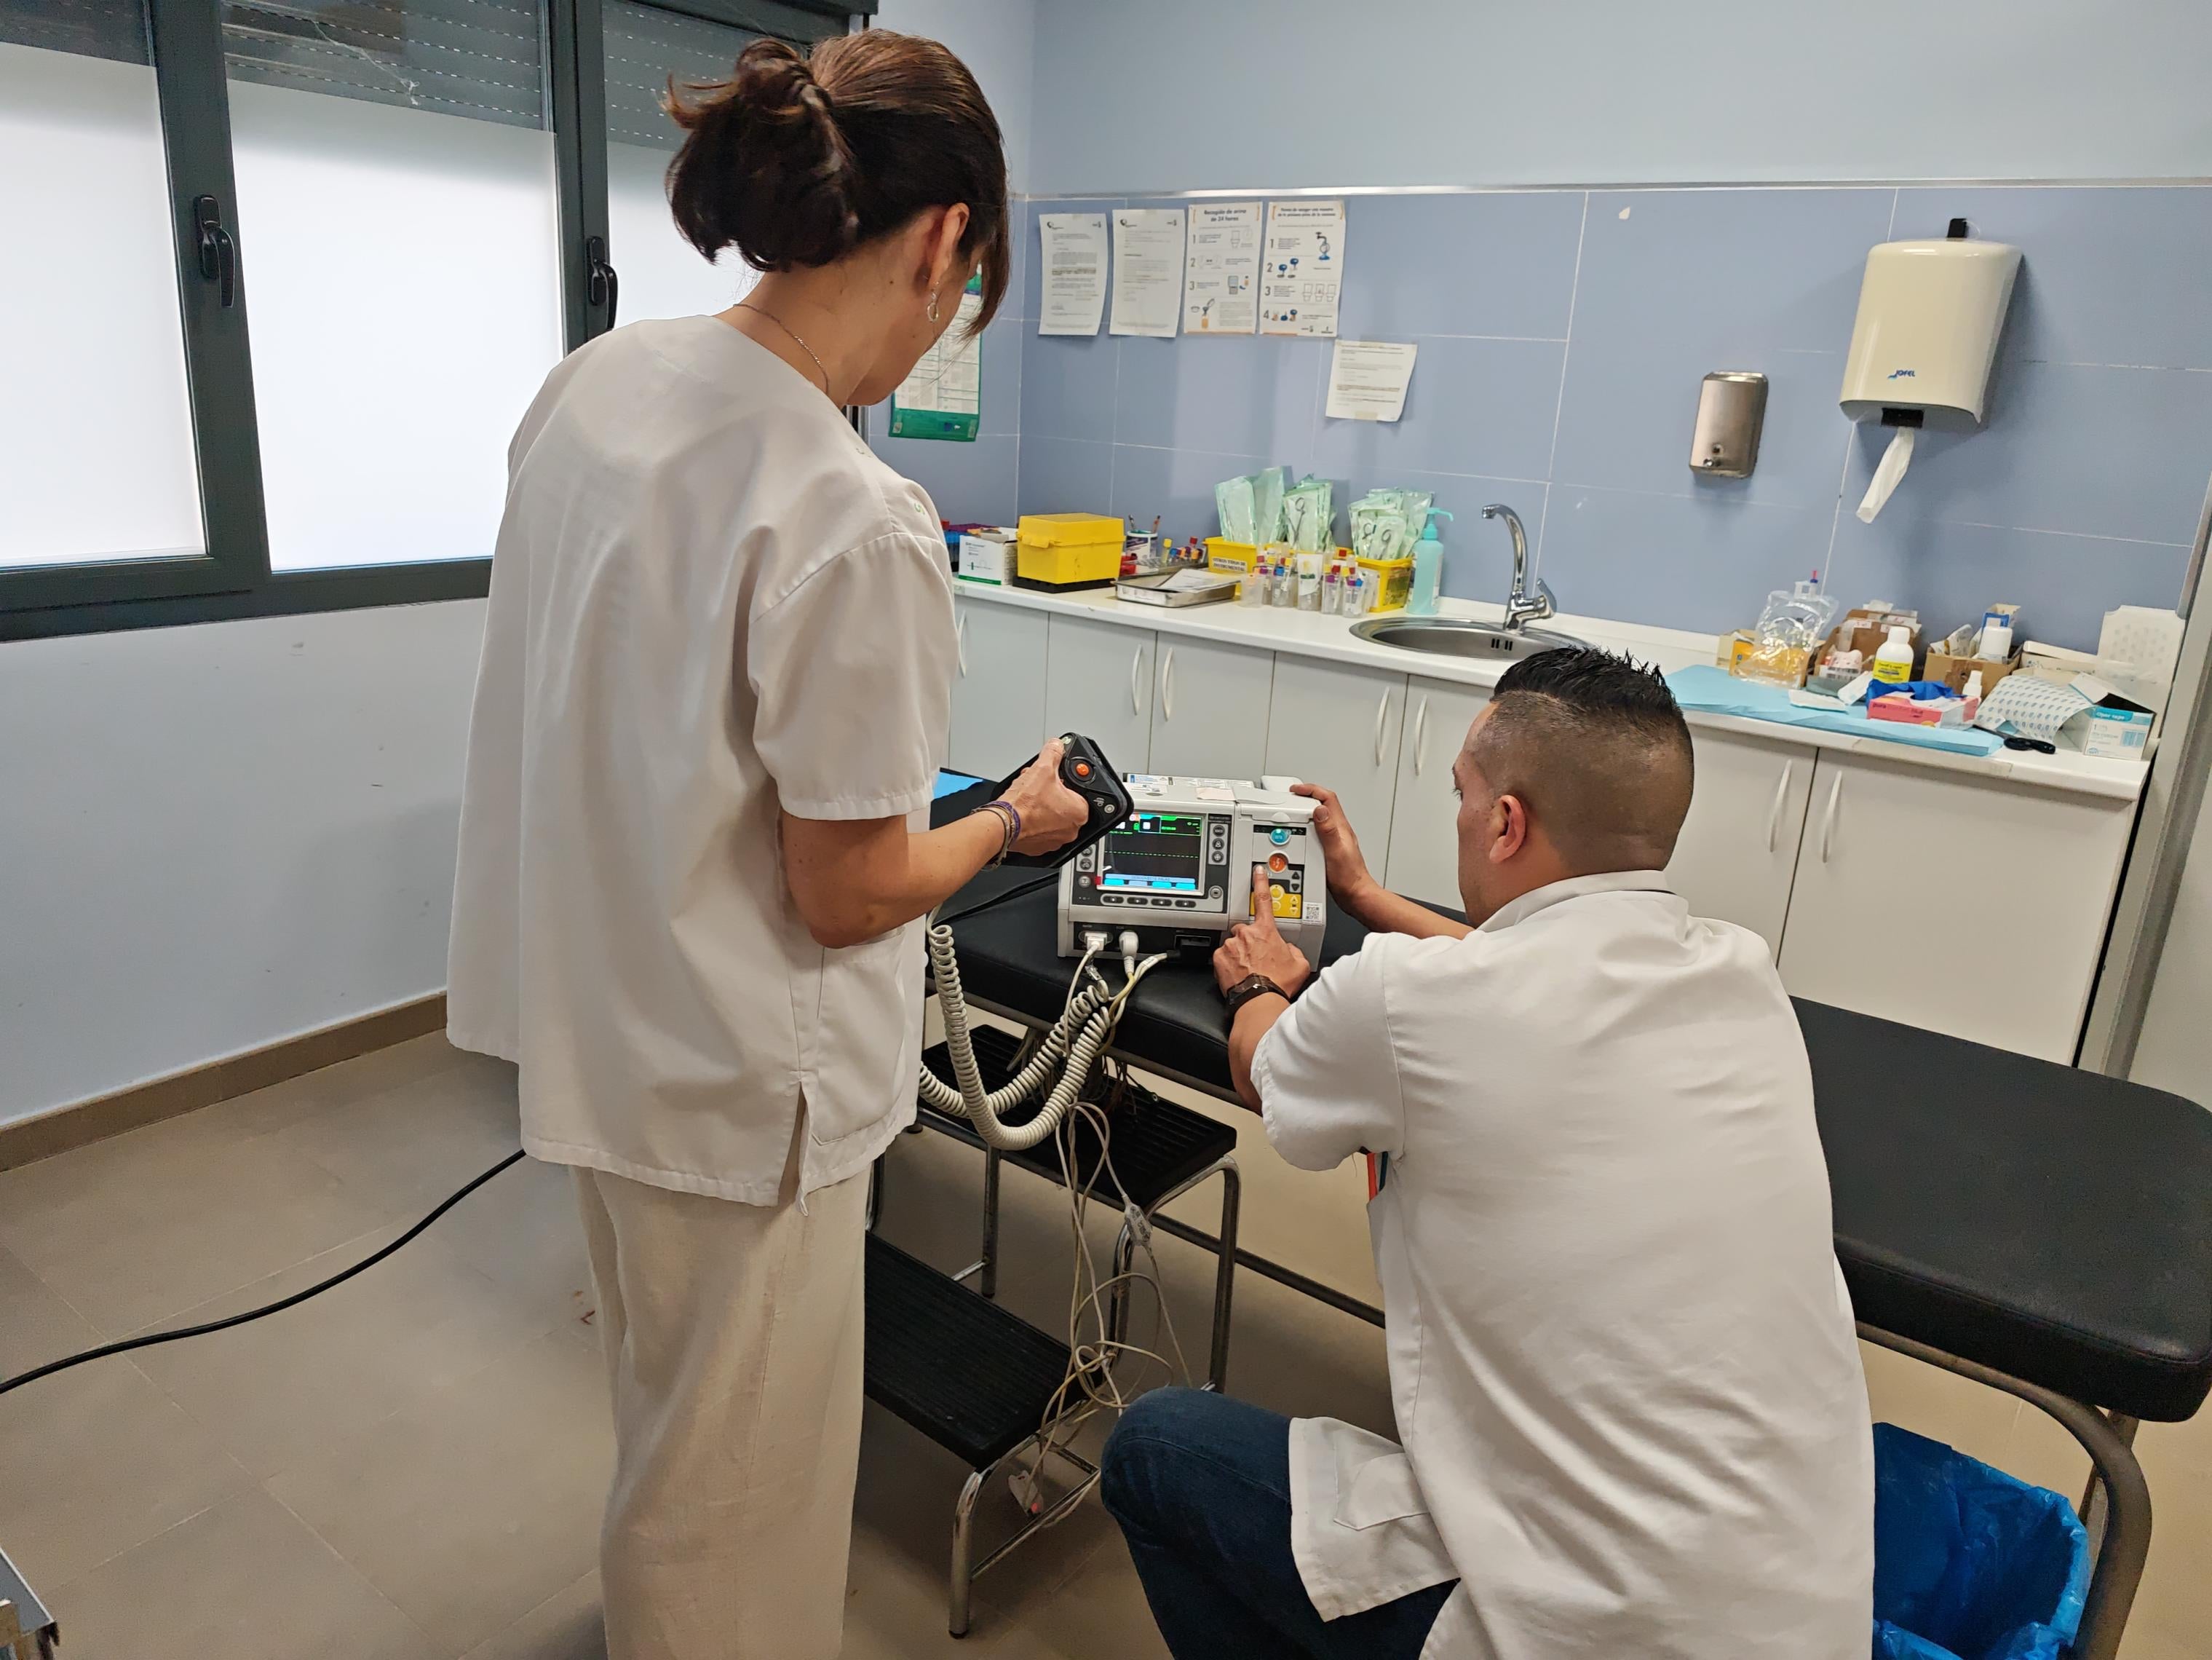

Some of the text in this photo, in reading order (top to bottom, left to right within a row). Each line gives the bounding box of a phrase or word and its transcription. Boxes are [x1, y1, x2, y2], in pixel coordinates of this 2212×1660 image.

[1270, 239, 1275, 249] 1
[1190, 257, 1196, 268] 2
[1266, 263, 1273, 273] 2
[1189, 280, 1195, 290] 3
[1264, 285, 1271, 296] 3
[1263, 309, 1269, 320] 4
[1892, 370, 1915, 378] JOFEL
